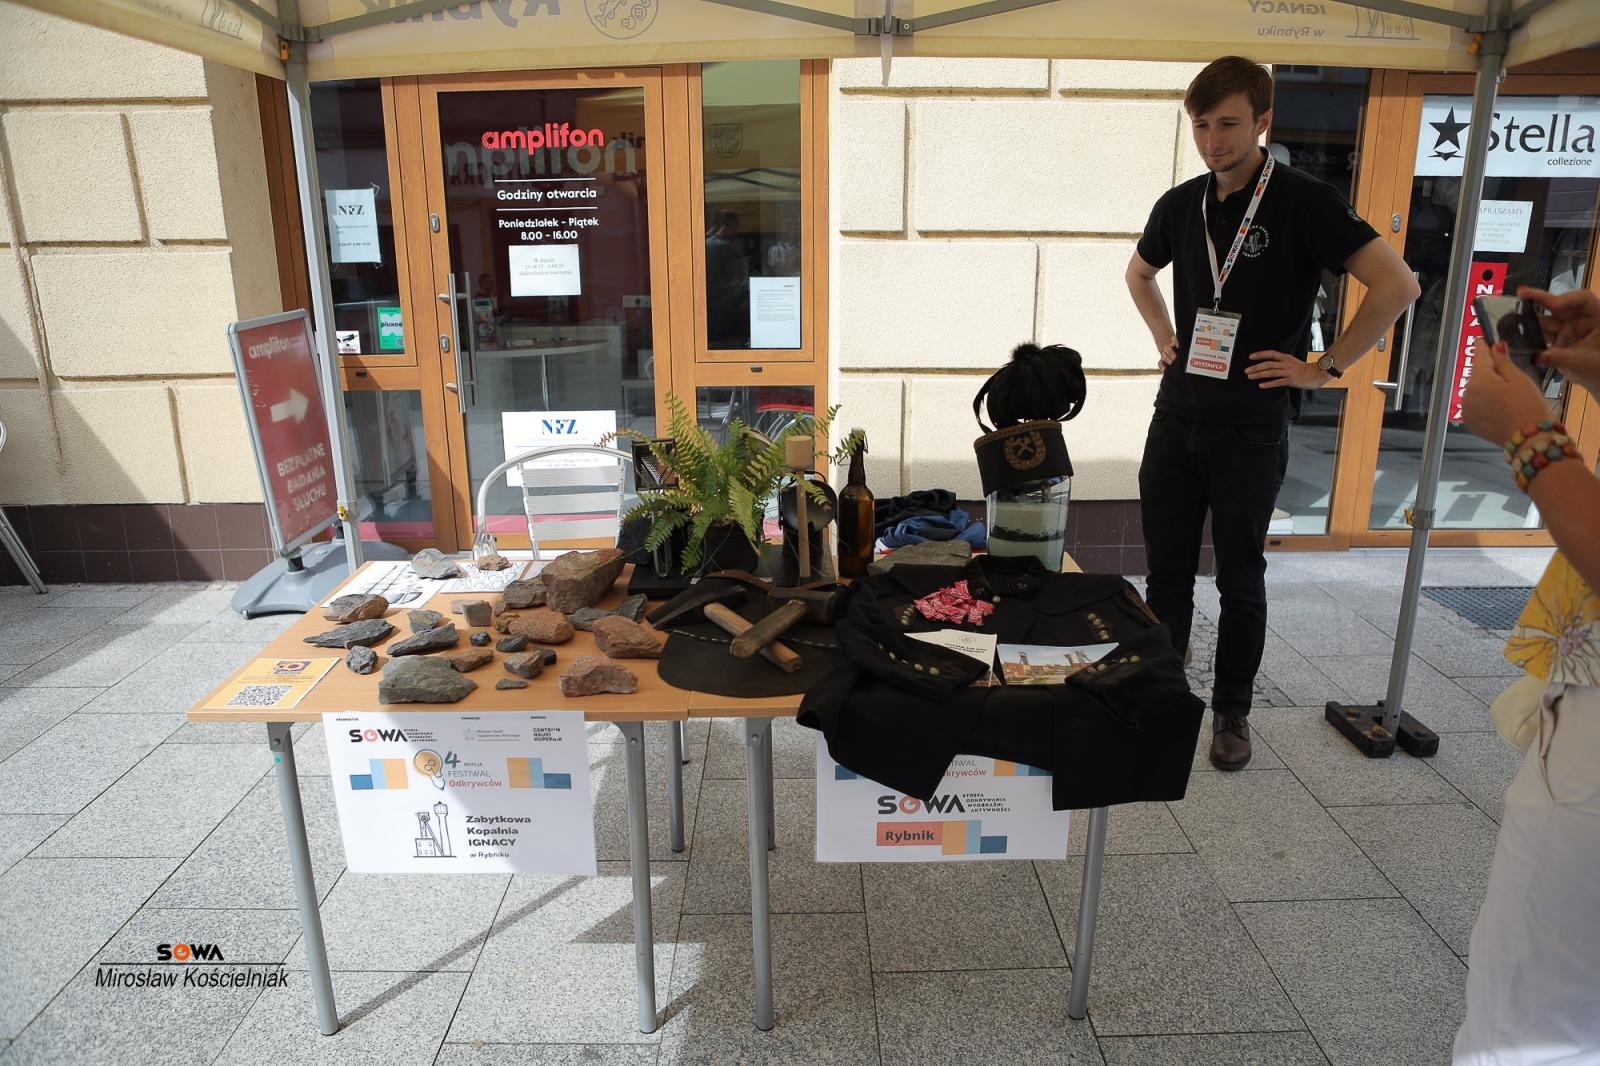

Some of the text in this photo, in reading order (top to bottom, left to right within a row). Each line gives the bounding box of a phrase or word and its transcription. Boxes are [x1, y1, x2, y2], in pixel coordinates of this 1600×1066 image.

[481, 122, 604, 155] amplifon
[1547, 157, 1593, 166] collezione
[497, 188, 597, 202] Godziny otwarcia
[338, 204, 365, 216] NFZ
[1480, 207, 1524, 216] APRASZAMY
[498, 218, 559, 228] Poniedziałek
[568, 217, 599, 228] Piątek
[521, 231, 543, 241] 8.00
[553, 230, 578, 240] 16.00
[542, 419, 578, 434] NFZ
[349, 728, 408, 743] SOWA
[444, 751, 461, 769] 4
[448, 770, 491, 778] FESTIWAL
[946, 768, 986, 778] krywców
[449, 779, 502, 789] Odkrywców
[878, 793, 966, 815] SOWA
[465, 815, 531, 824] Zabytkowa
[467, 827, 519, 836] Kopalnia
[885, 830, 935, 843] Rybnik
[468, 838, 516, 846] IGNACY
[478, 851, 510, 859] Rybniku
